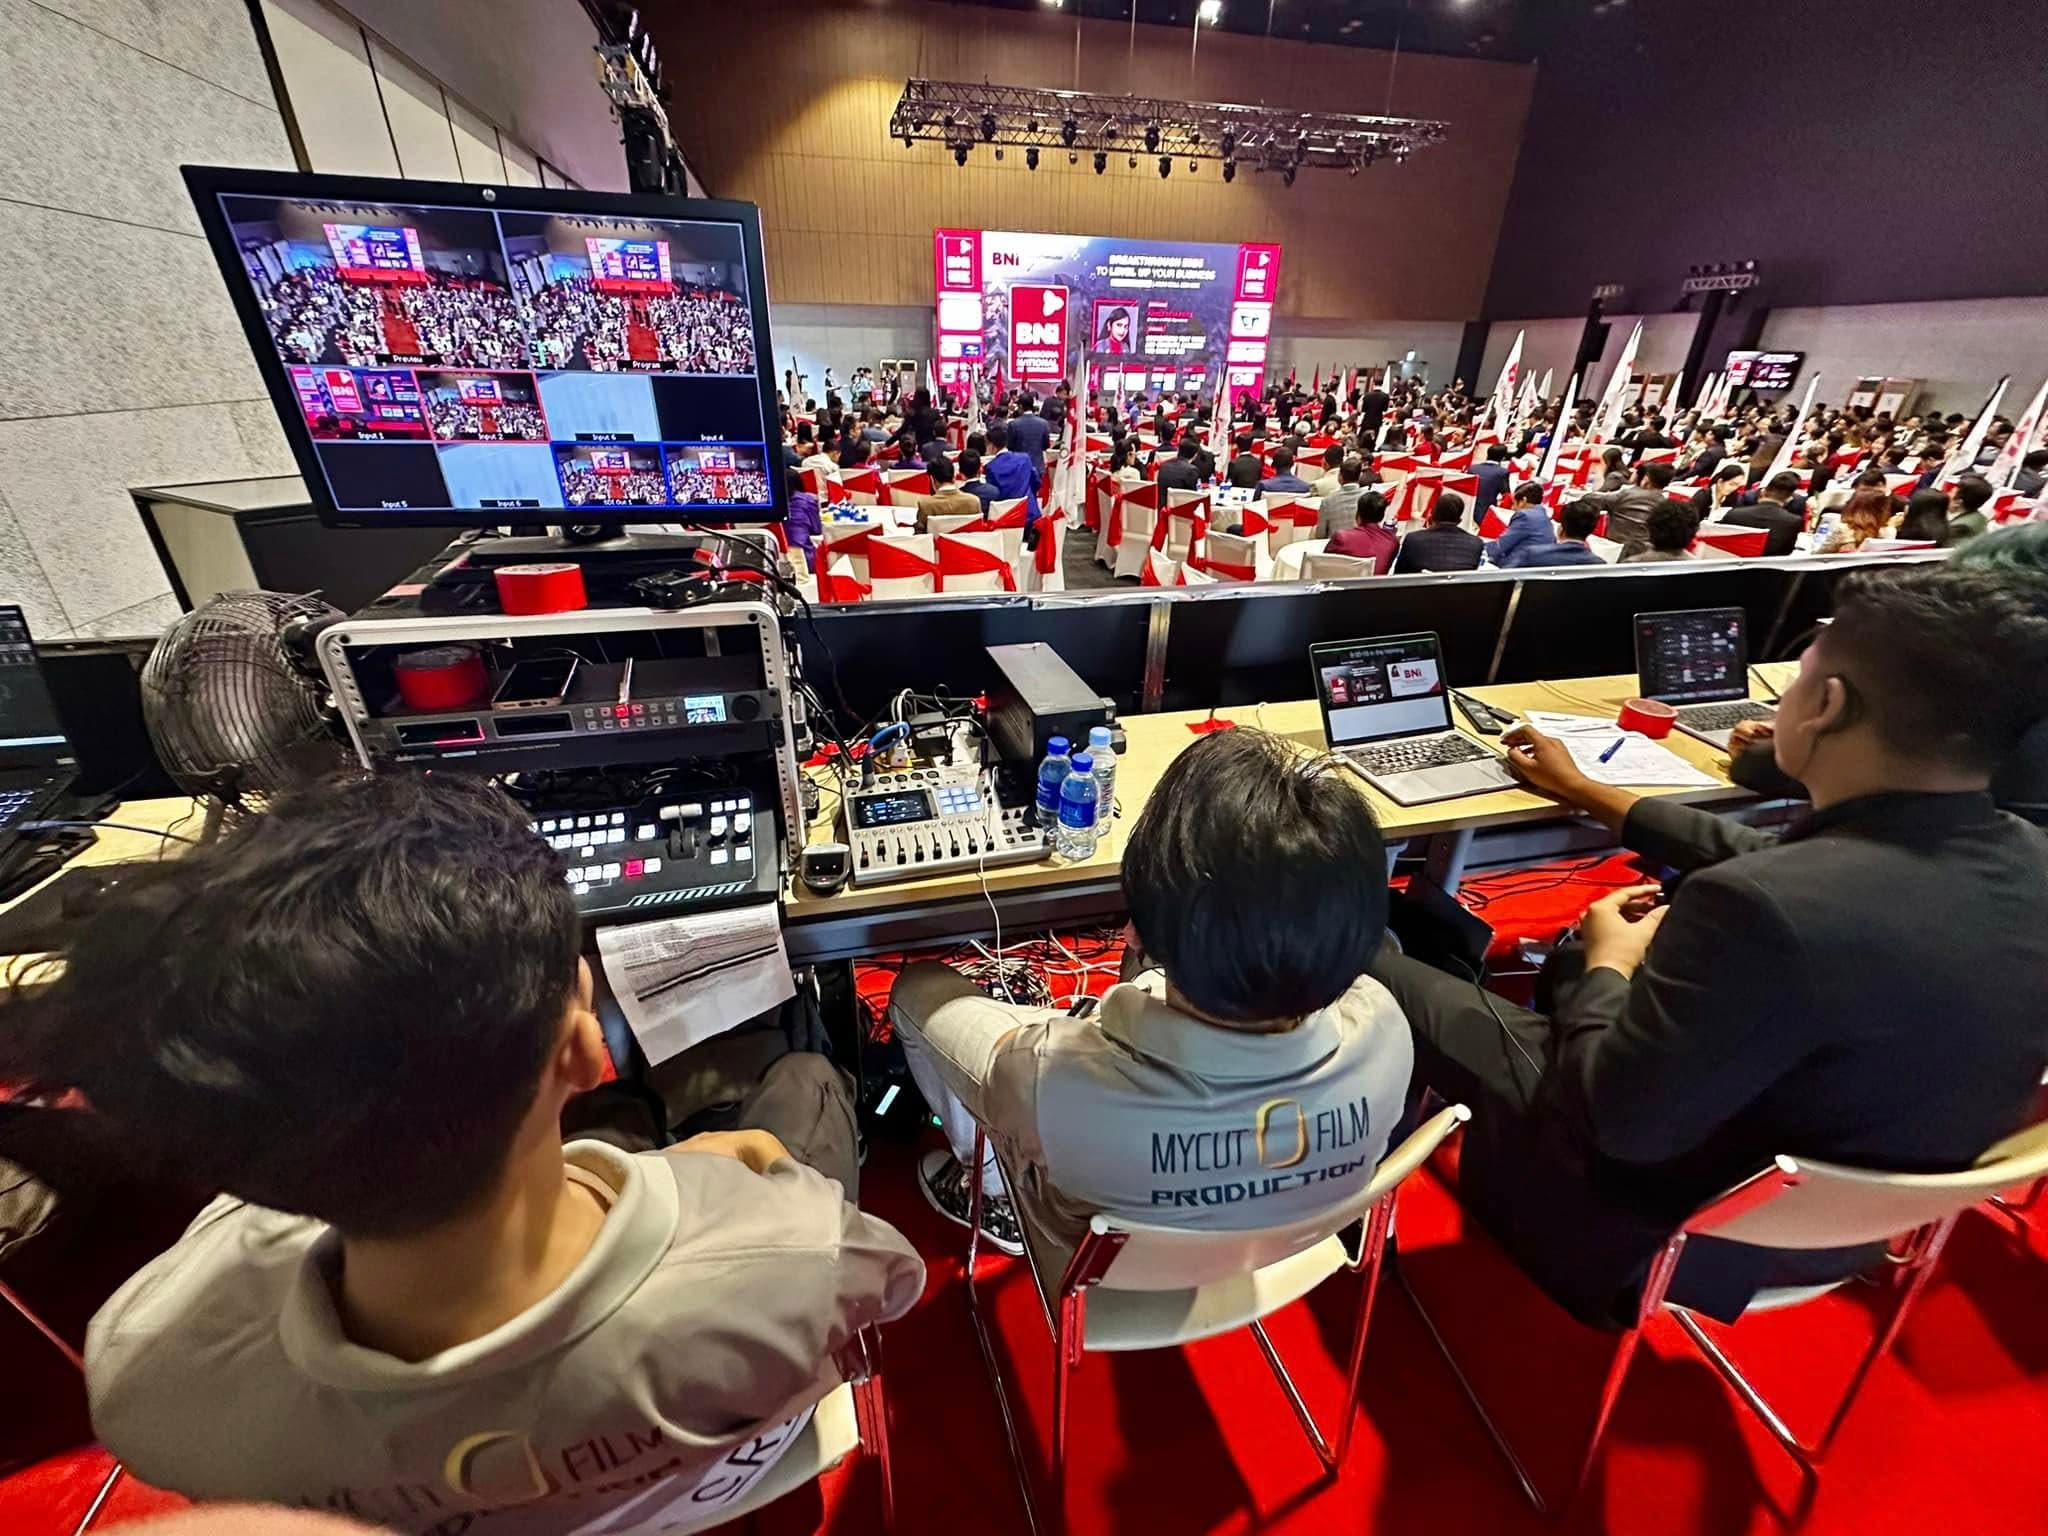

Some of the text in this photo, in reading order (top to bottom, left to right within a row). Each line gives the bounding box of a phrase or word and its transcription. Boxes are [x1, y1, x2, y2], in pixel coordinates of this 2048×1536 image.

[1096, 266, 1108, 276] TO
[1152, 268, 1175, 279] YOUR
[632, 361, 661, 370] Program
[358, 432, 378, 441] Input
[478, 432, 496, 442] Input
[592, 434, 610, 442] Input
[701, 434, 717, 442] Input
[381, 501, 401, 509] Input
[497, 500, 515, 508] Input
[1152, 1096, 1370, 1174] MYCUT FILM
[1151, 1155, 1366, 1207] PRODUCTION
[562, 1426, 663, 1482] FILM
[692, 1418, 793, 1503] CR
